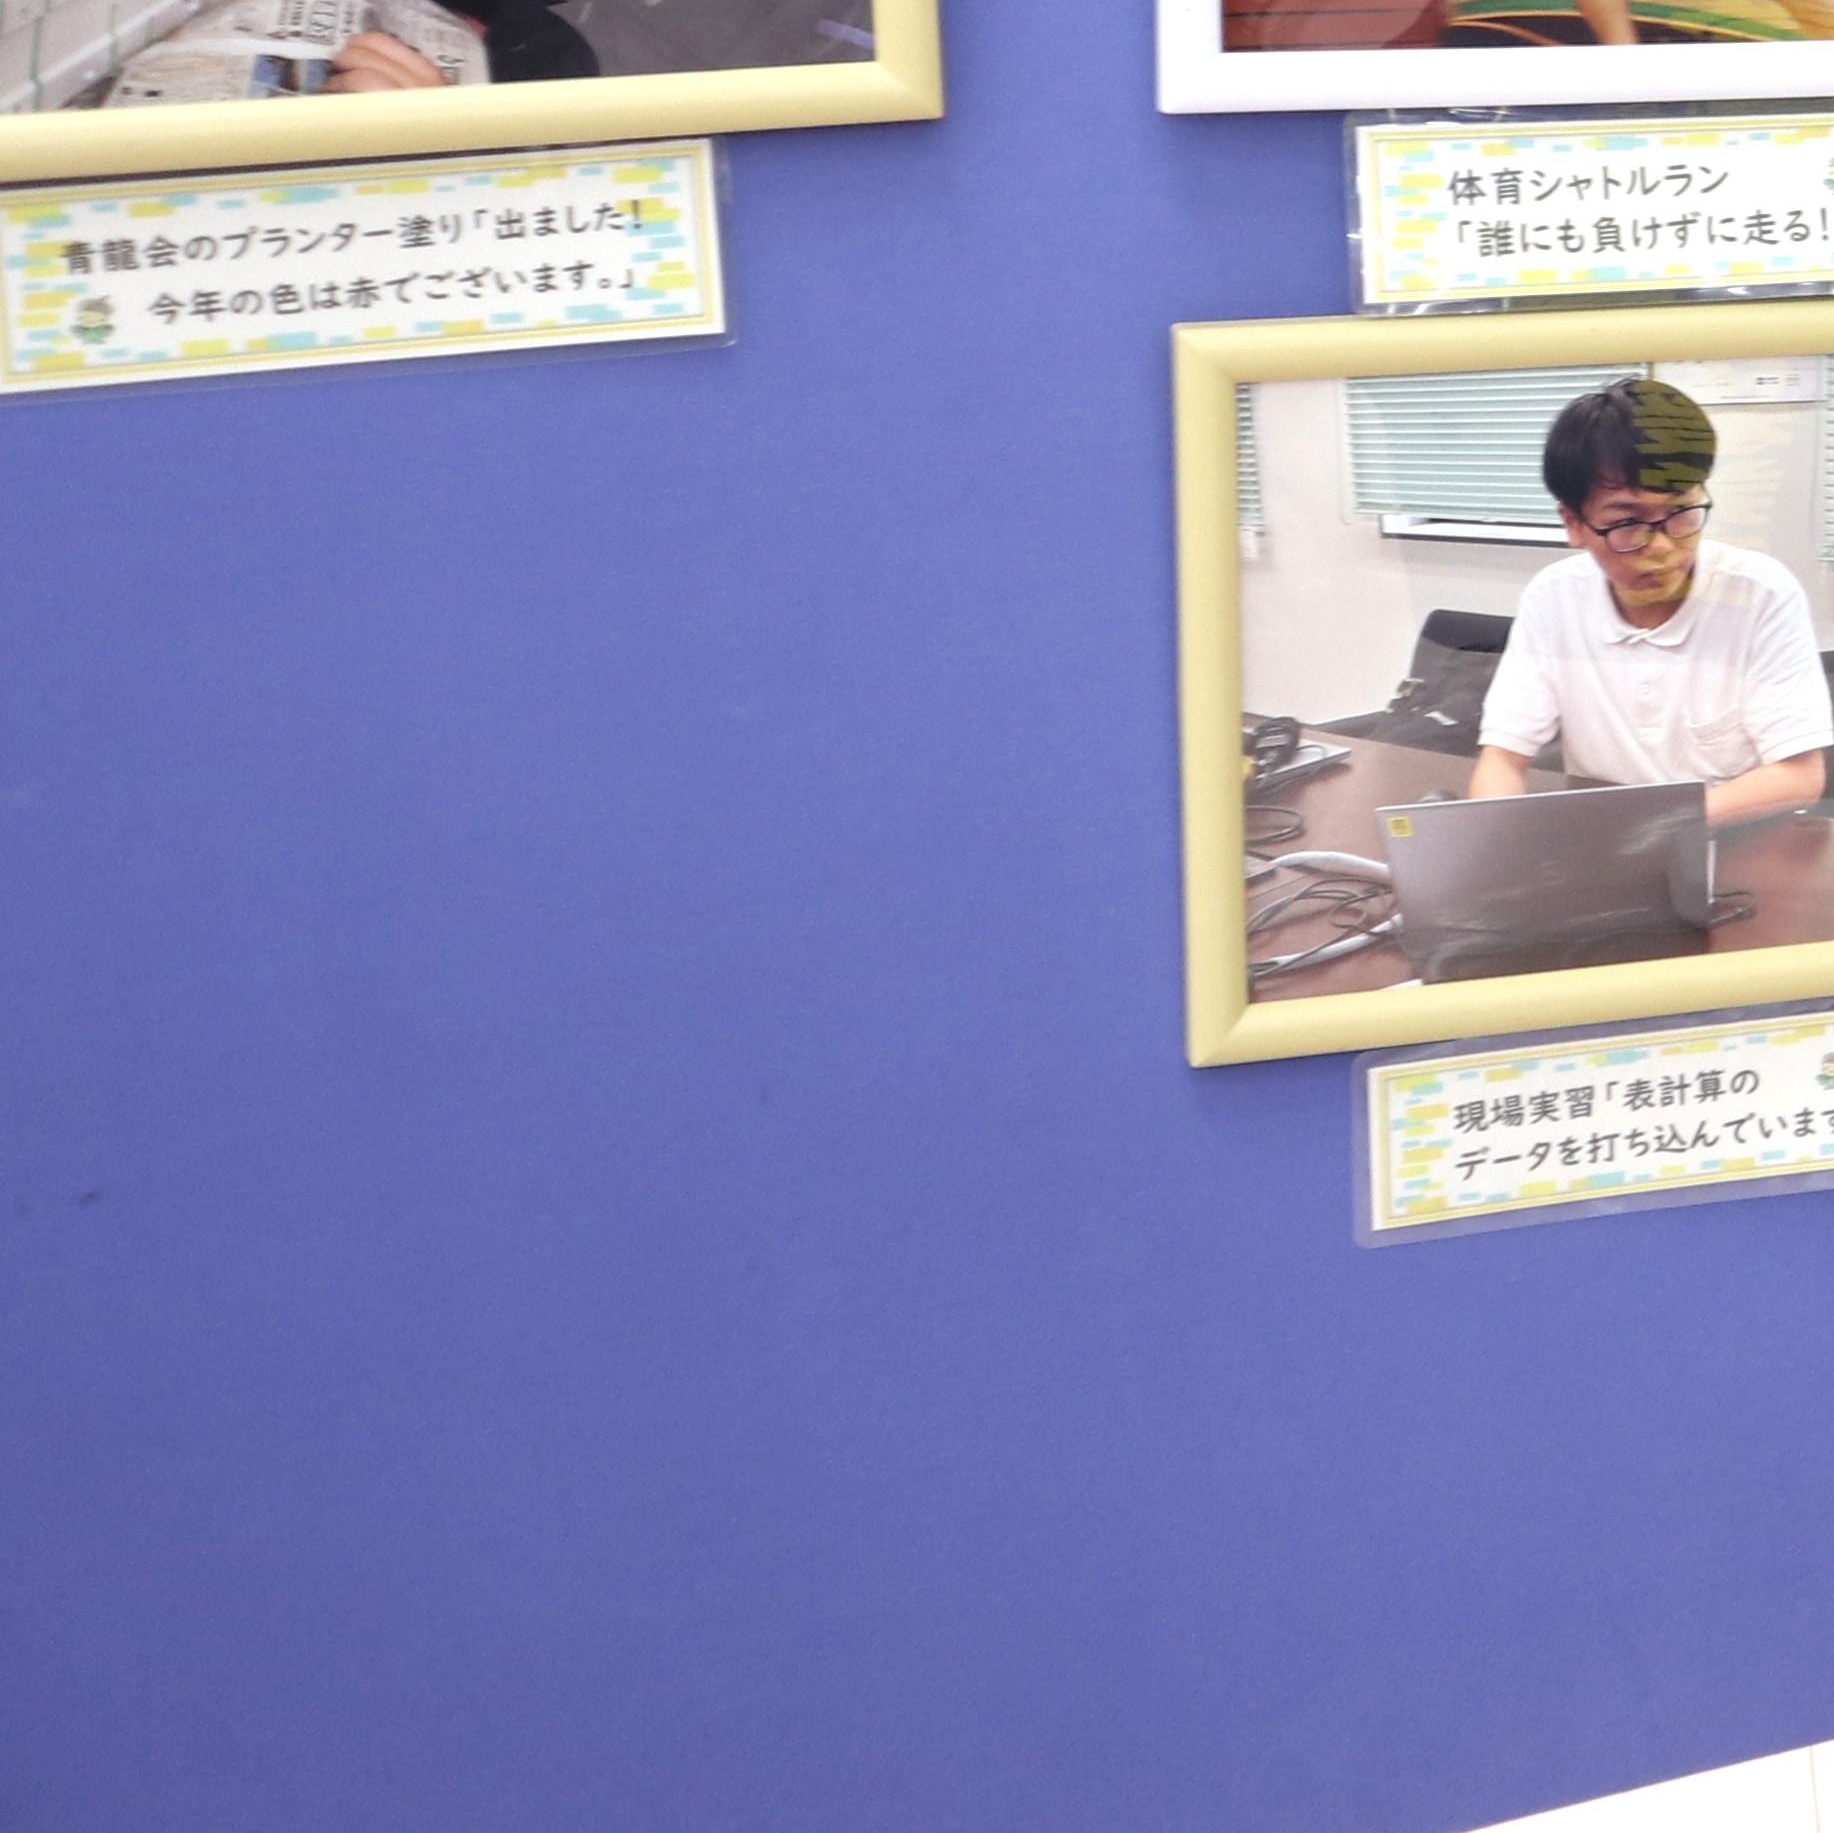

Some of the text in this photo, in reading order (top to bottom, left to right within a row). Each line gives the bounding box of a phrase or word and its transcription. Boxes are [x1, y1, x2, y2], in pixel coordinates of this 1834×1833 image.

[1449, 164, 1730, 207] 体育シャトルラン
[148, 262, 637, 326] 今年の色は赤でございます。」
[1453, 1068, 1760, 1134] 現場実習「表計算の
